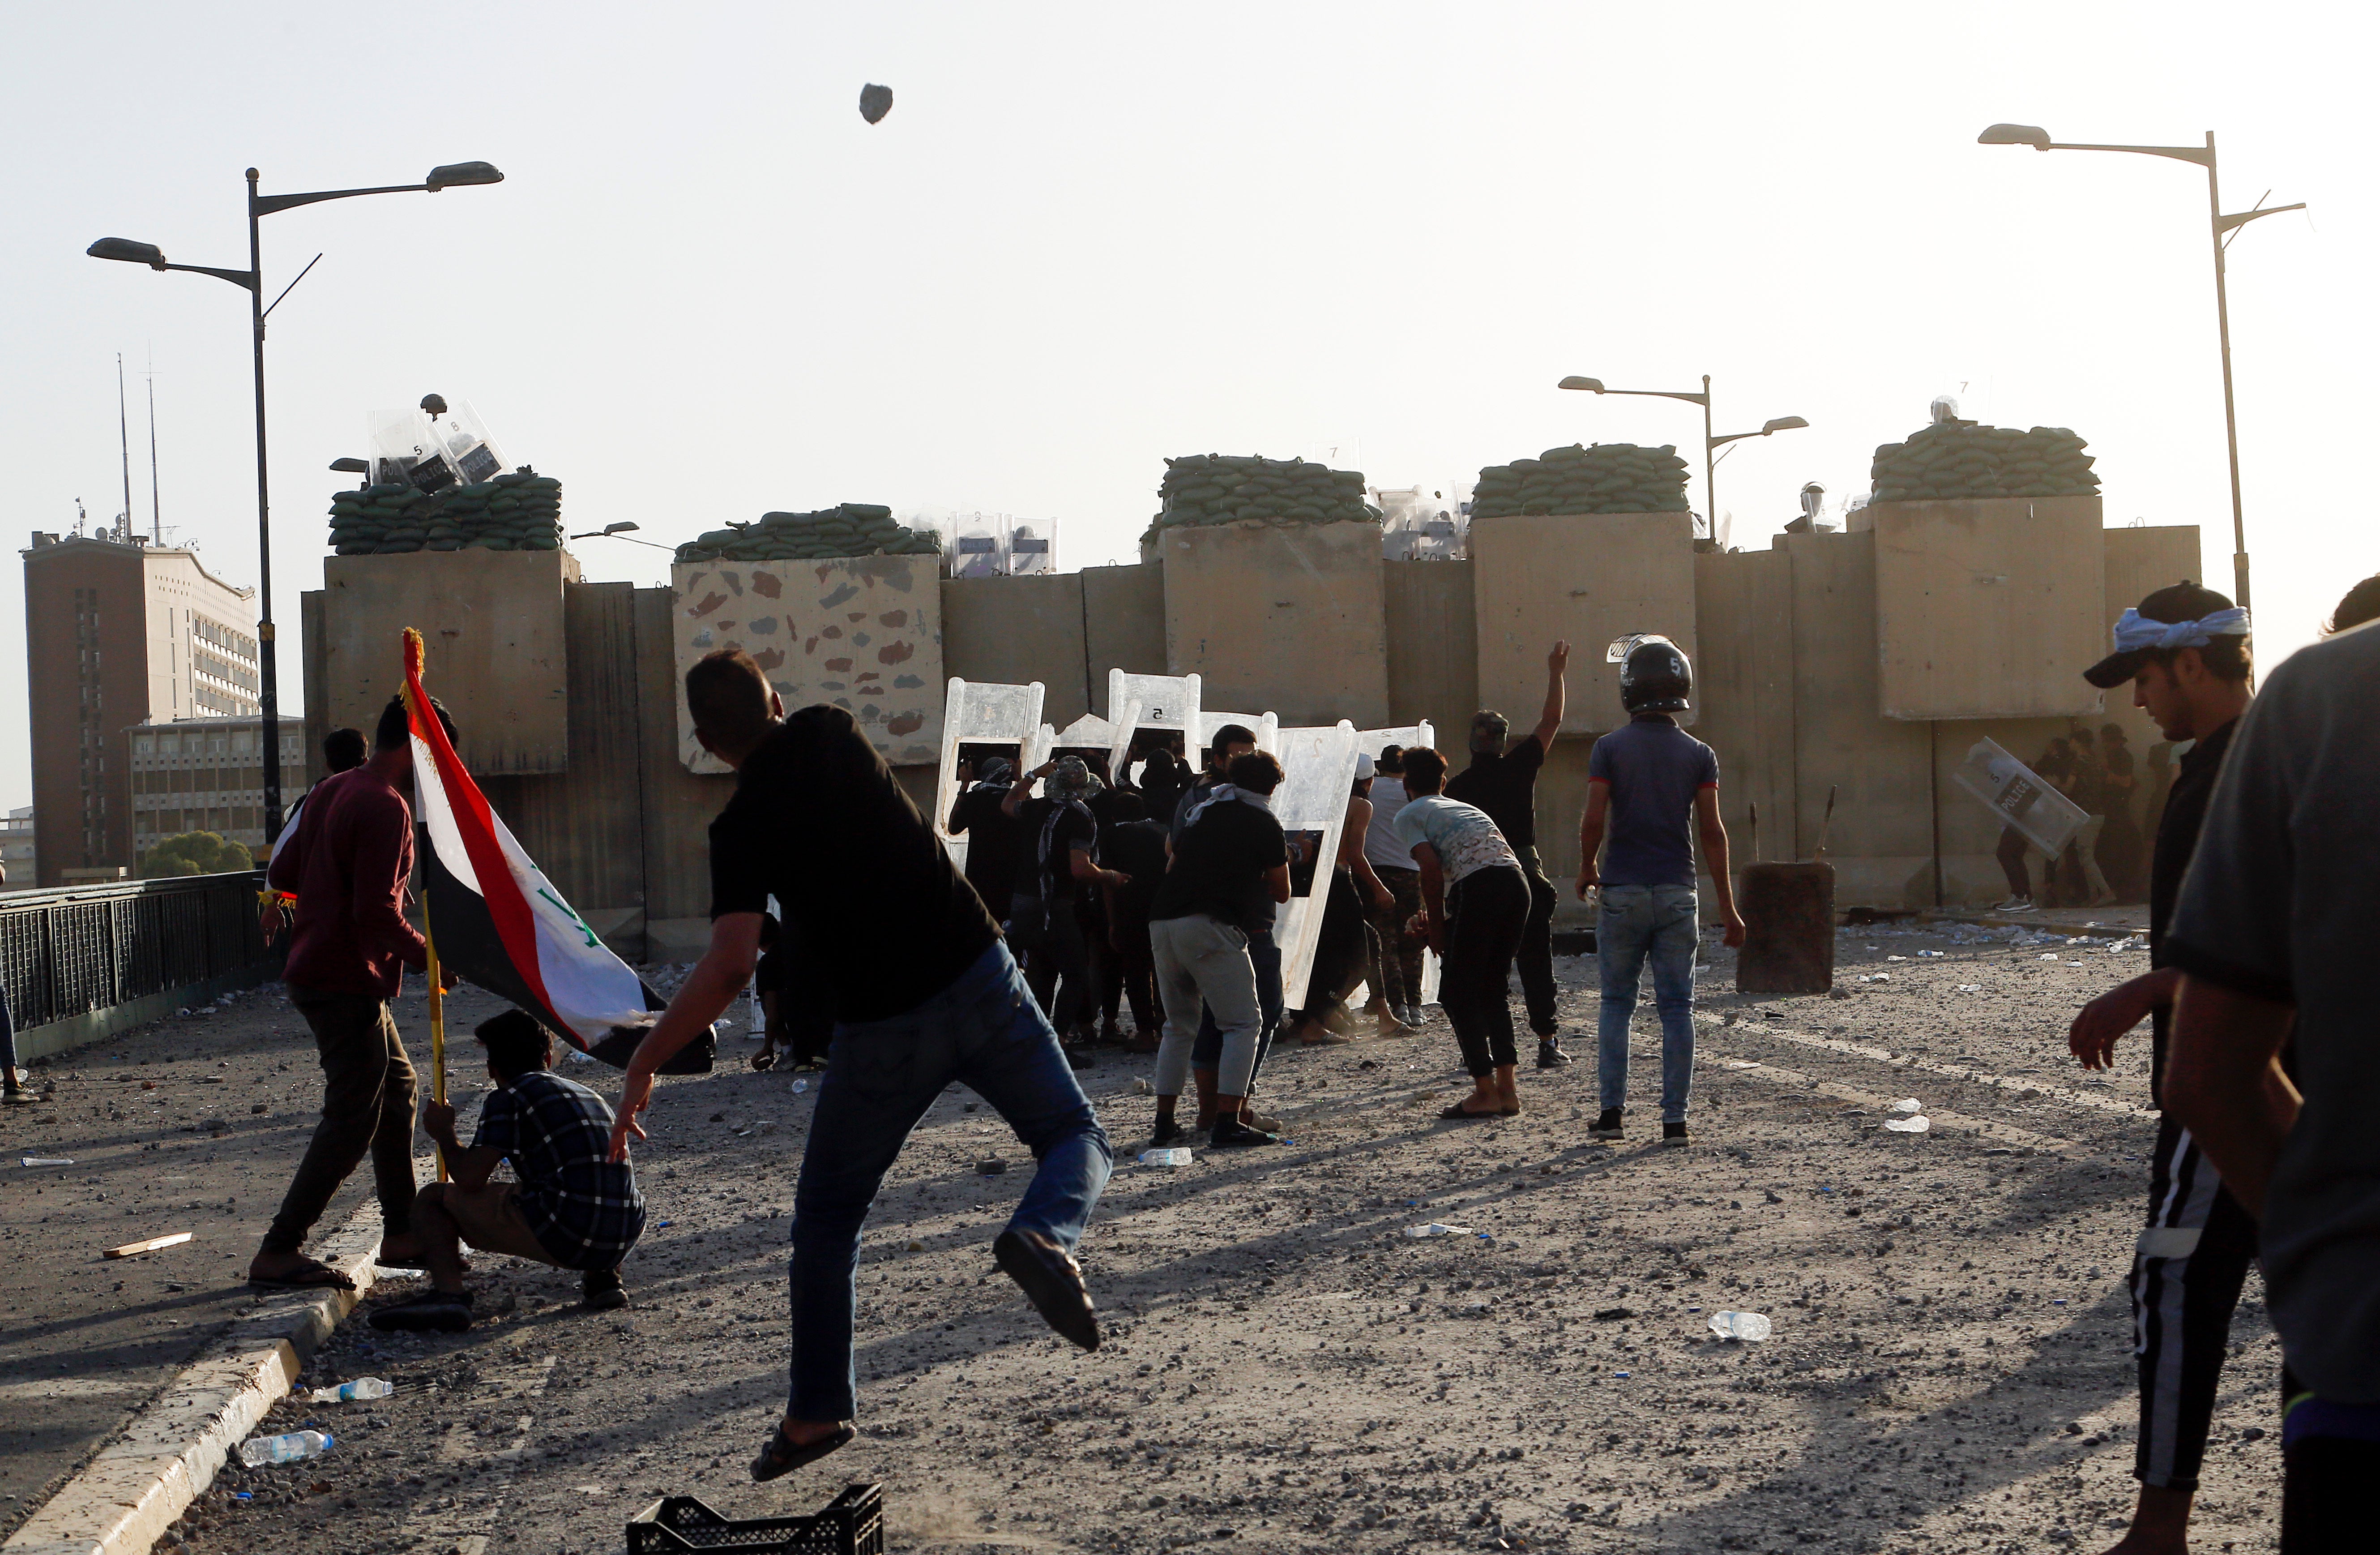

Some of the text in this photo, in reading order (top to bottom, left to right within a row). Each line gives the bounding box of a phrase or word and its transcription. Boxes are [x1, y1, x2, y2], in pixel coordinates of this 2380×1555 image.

[1960, 381, 1969, 394] 7
[450, 422, 459, 432] 8
[414, 446, 423, 456] 5
[1329, 447, 1338, 458] 7
[463, 450, 492, 476] POLICE
[1670, 657, 1681, 674] 5
[1990, 773, 2000, 784] 5
[2002, 780, 2030, 812] POLICE
